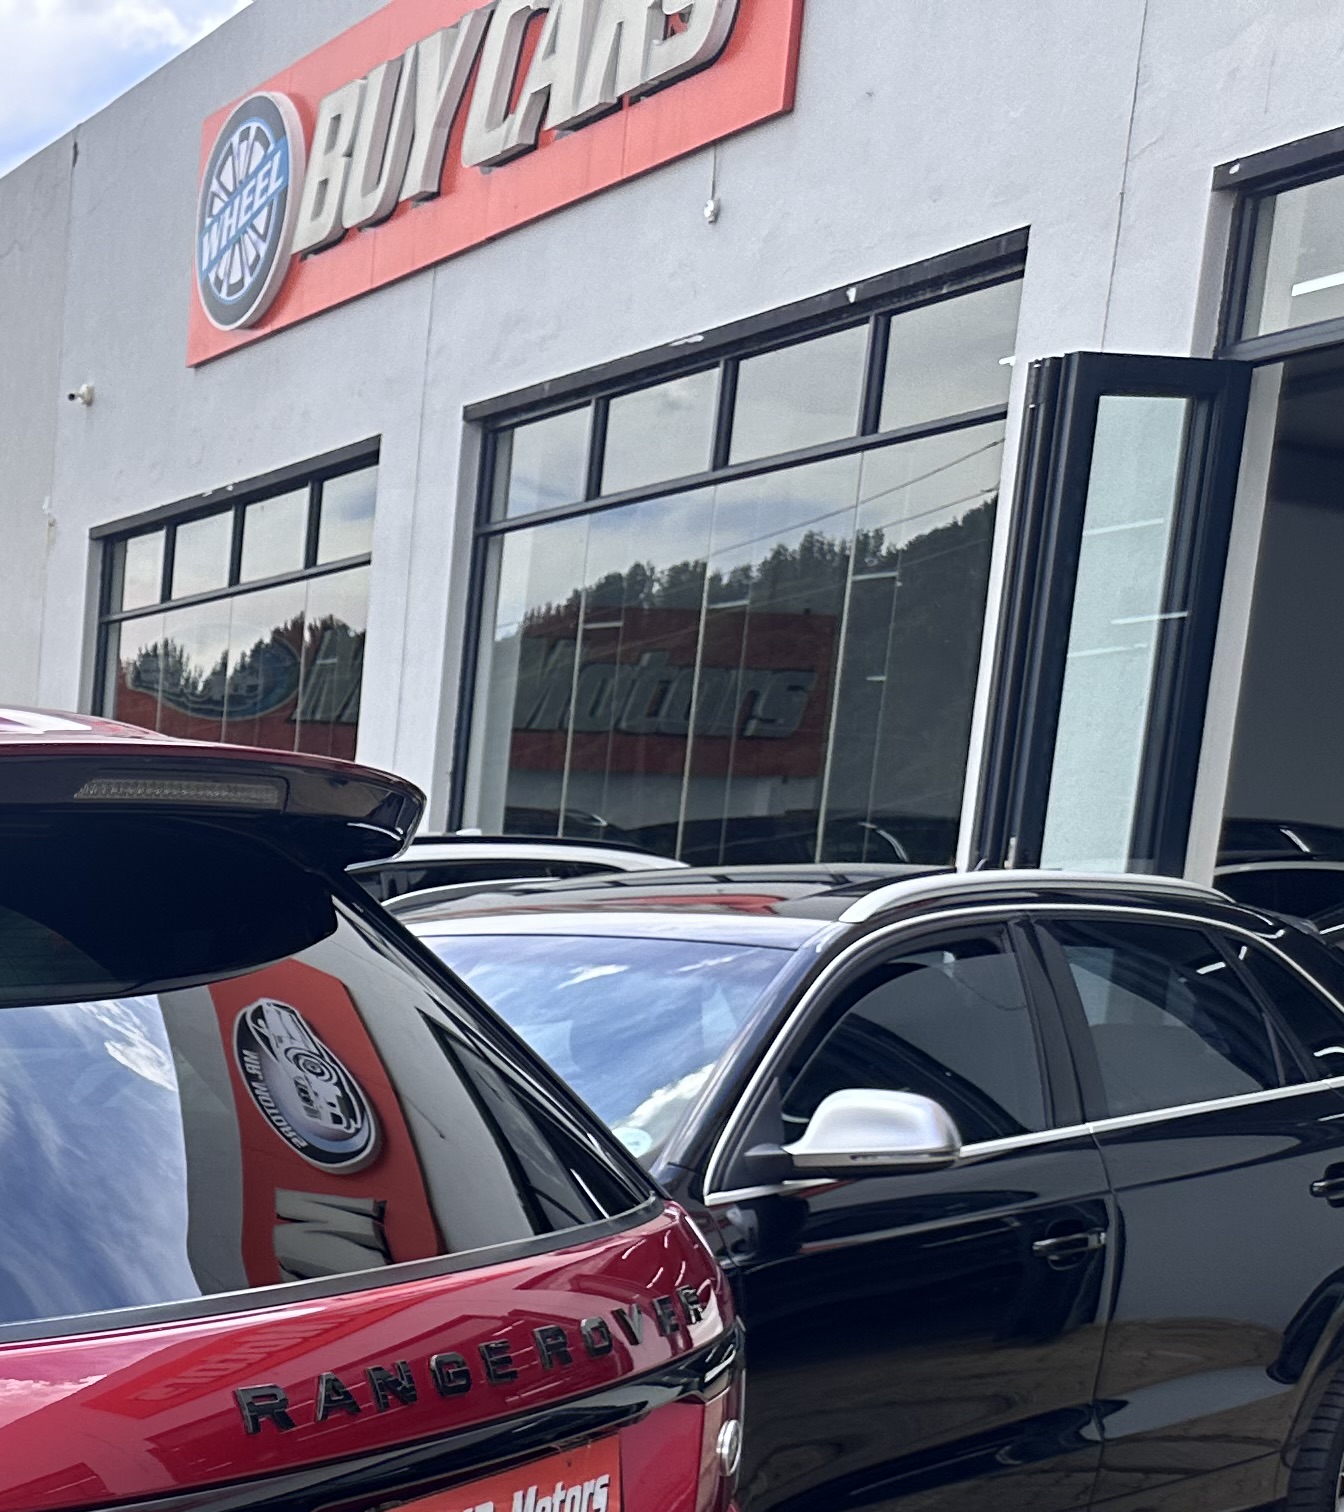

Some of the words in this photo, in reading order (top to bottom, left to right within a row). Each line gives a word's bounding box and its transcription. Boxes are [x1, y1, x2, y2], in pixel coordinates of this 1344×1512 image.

[291, 10, 488, 256] BUY
[201, 150, 283, 271] WHEEL
[235, 1339, 518, 1434] RANGE
[532, 1284, 703, 1370] ROVER
